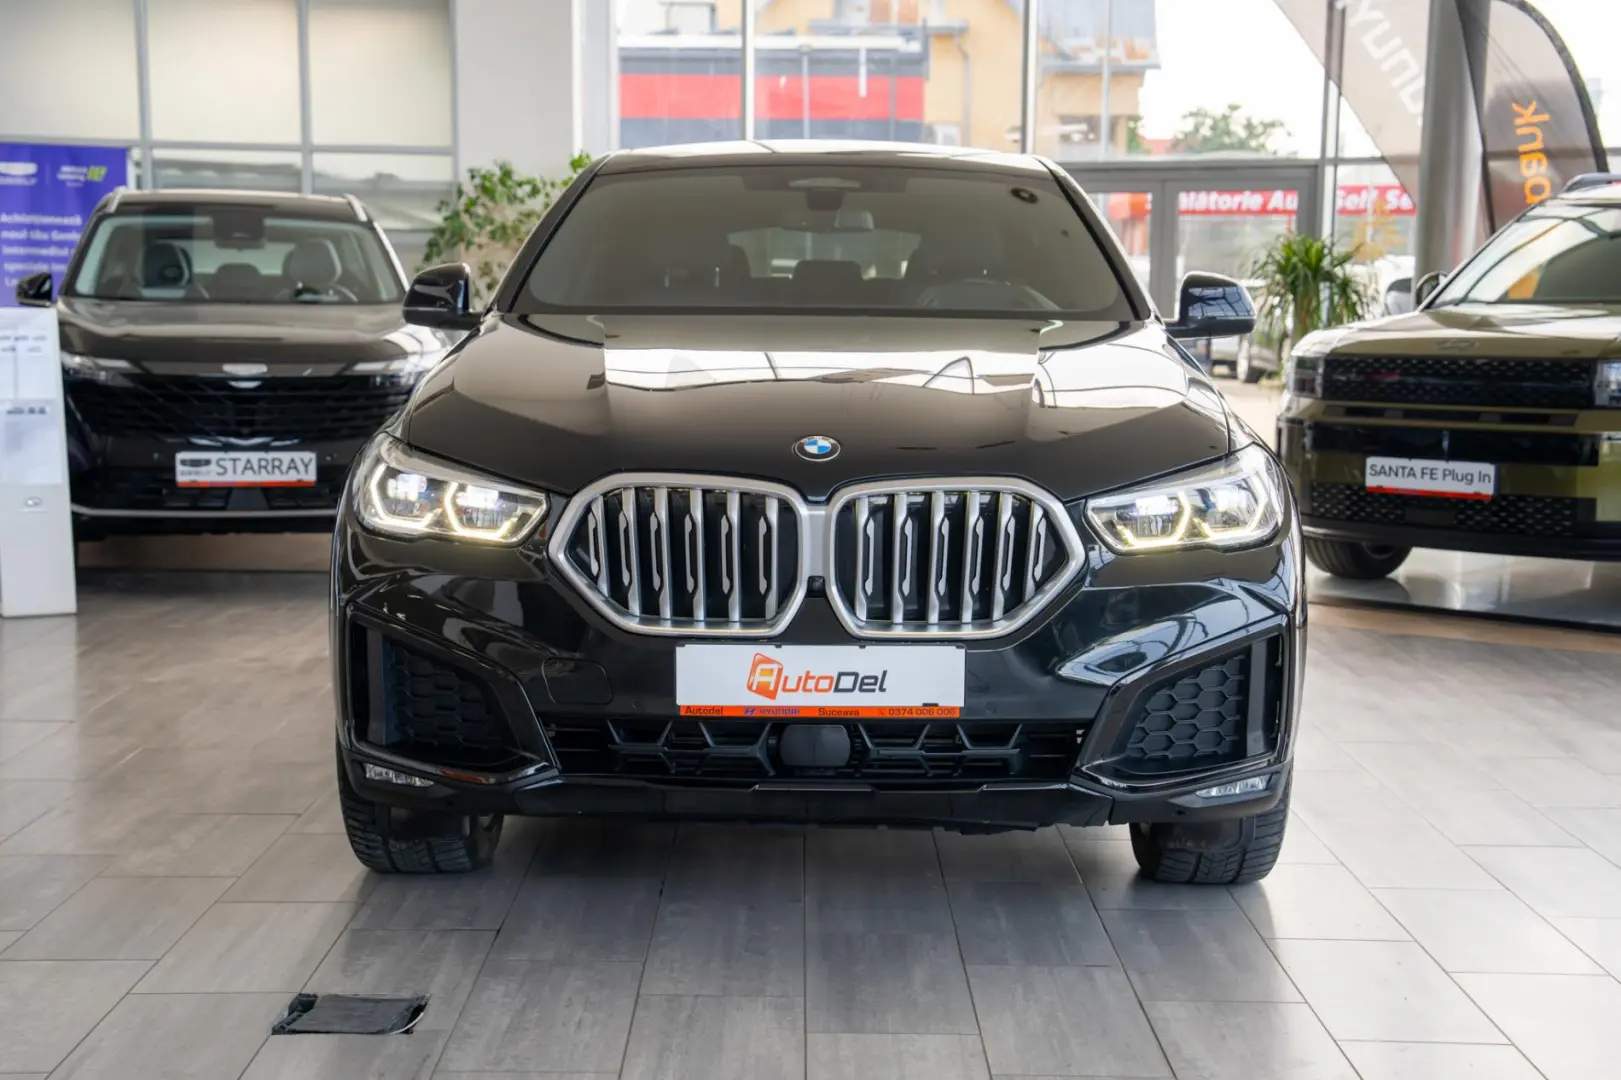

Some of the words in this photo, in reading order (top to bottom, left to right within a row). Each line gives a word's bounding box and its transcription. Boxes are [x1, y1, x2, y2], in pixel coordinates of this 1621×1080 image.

[216, 457, 312, 477] STARRAY
[1369, 464, 1417, 479] SANTA
[1420, 467, 1439, 480] FE
[1442, 468, 1474, 485] Plug
[1478, 470, 1492, 483] In
[746, 652, 888, 701] AutoDel
[685, 705, 724, 716] Autodel
[818, 707, 860, 717] Suceava
[888, 707, 914, 717] 0374
